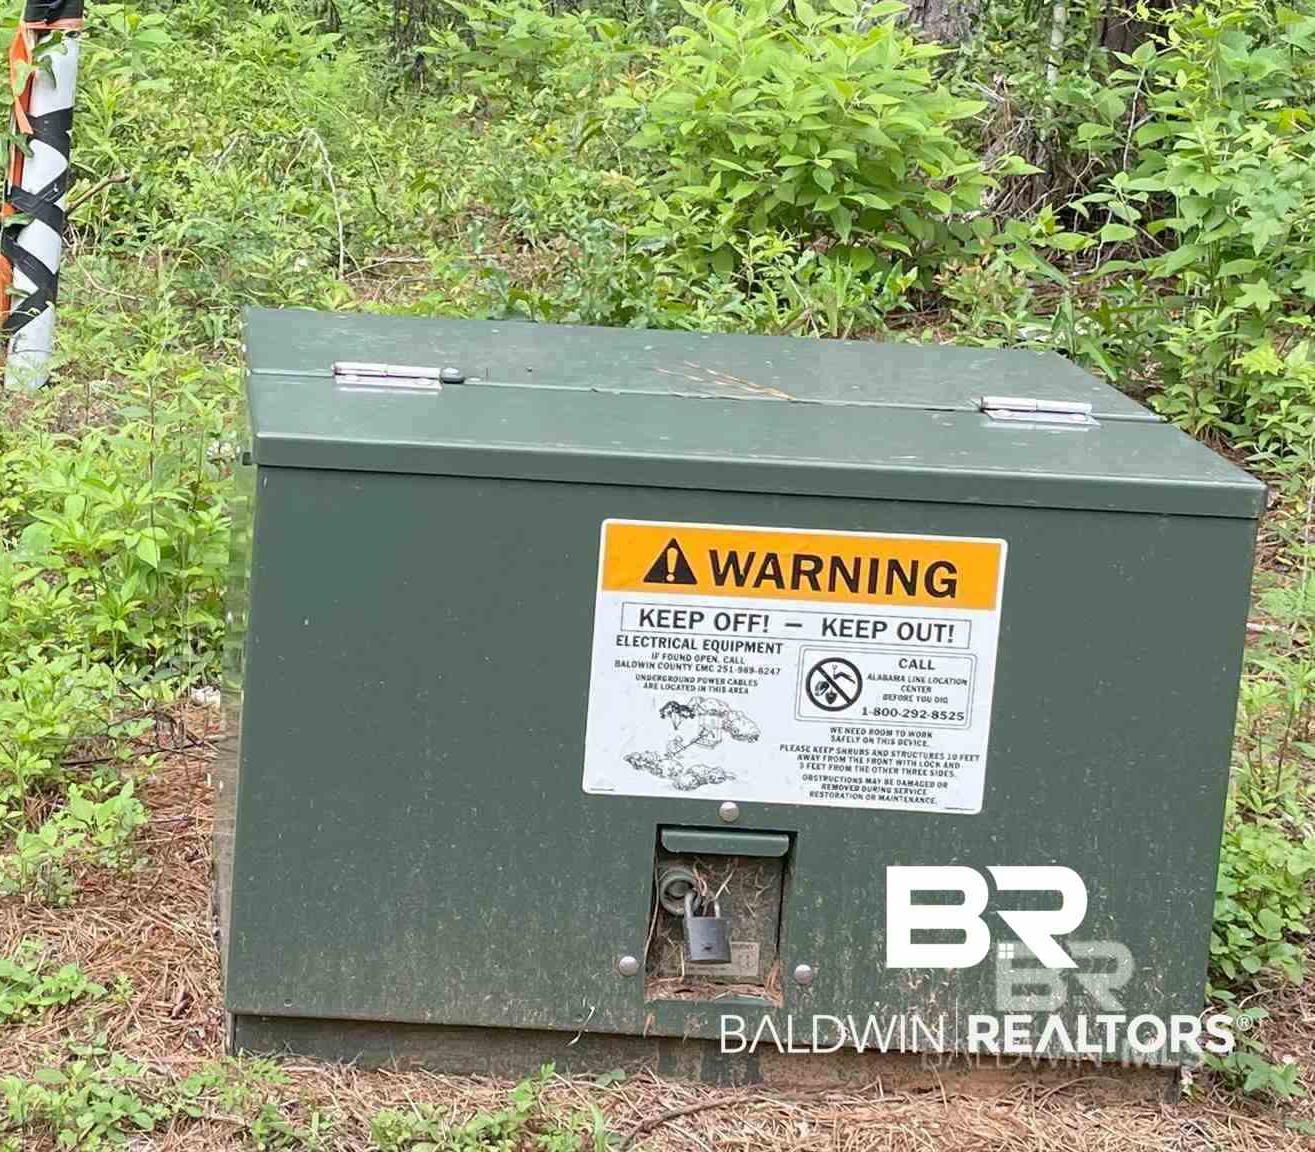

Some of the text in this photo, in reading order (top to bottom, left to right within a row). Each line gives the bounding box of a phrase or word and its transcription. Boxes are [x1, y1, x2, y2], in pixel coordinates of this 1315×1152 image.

[709, 549, 957, 599] WARNING
[639, 609, 704, 632] KEEP
[714, 612, 769, 634] OFF!
[822, 618, 887, 640] KEEP
[897, 622, 954, 643] OUT!
[616, 635, 784, 654] ELECTRICAL EQUIPMENT
[652, 652, 659, 660] IF
[662, 653, 692, 662] FOUND
[723, 656, 745, 664] CALL
[898, 658, 936, 670] CALL
[615, 660, 655, 669] BALDWIN
[658, 662, 692, 671] COUNTY
[695, 664, 714, 672] EMC
[635, 674, 758, 687] UNDERGROUND POWER CABLES
[867, 673, 968, 686] ALABAMA LINE LOCATION
[661, 683, 696, 692] LOCATED
[728, 686, 749, 694] AREA
[901, 685, 932, 693] CENTER
[883, 694, 949, 704] BEFORE YOU DIG
[862, 707, 965, 721] 1-800-292-8525
[830, 727, 843, 735] WE
[845, 728, 866, 736] NEED
[869, 729, 893, 737] ROOM
[908, 730, 933, 738] WORK
[830, 735, 860, 743] SAFELY
[780, 744, 811, 753] PLEASE
[813, 746, 834, 754] KEEP
[836, 747, 869, 756] SHRUBS
[871, 749, 888, 757] AND
[891, 750, 944, 760] STRUCTURES
[960, 754, 980, 762] FEET
[797, 754, 960, 769] AWAY FROM THE FRONT WITH LOCK AND
[806, 763, 826, 771] FEET
[829, 764, 852, 772] FROM
[855, 765, 869, 773] THE
[872, 766, 898, 774] OTHER
[901, 768, 928, 776] THREE
[802, 774, 948, 789] OBSTRUCTIONS MAY BE DAMAGED OR
[821, 783, 860, 791] REMOVED
[862, 785, 892, 793] DURING
[809, 791, 863, 800] RESTORATION
